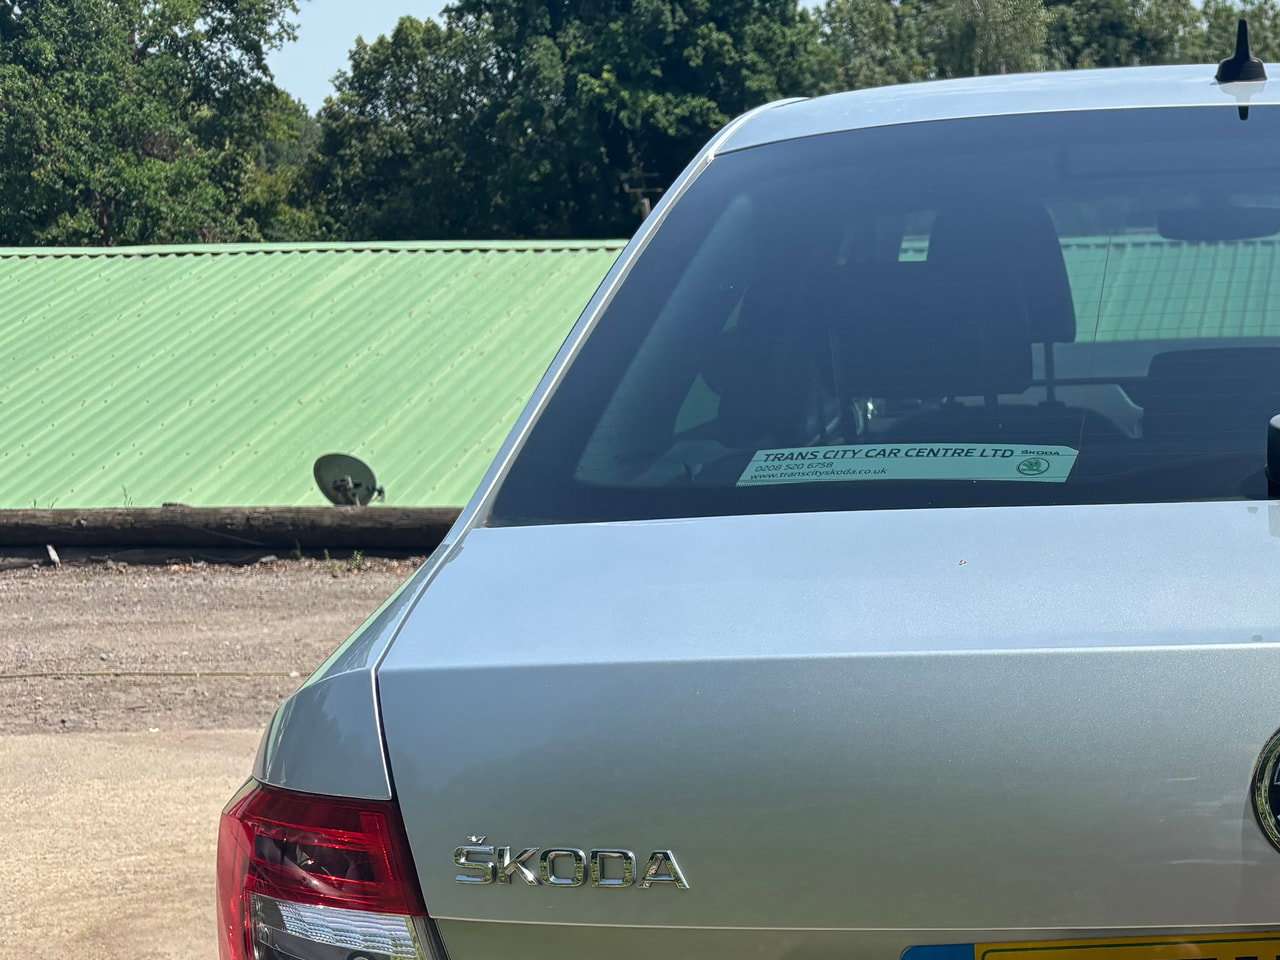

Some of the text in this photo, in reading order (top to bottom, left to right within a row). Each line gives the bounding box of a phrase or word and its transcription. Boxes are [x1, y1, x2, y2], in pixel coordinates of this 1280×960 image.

[763, 447, 1015, 463] TRANS CITY CAR CENTRE LTD
[750, 467, 888, 480] www.transcityskoda.co.uk
[783, 463, 805, 471] 520
[454, 832, 690, 889] ŠKODA
